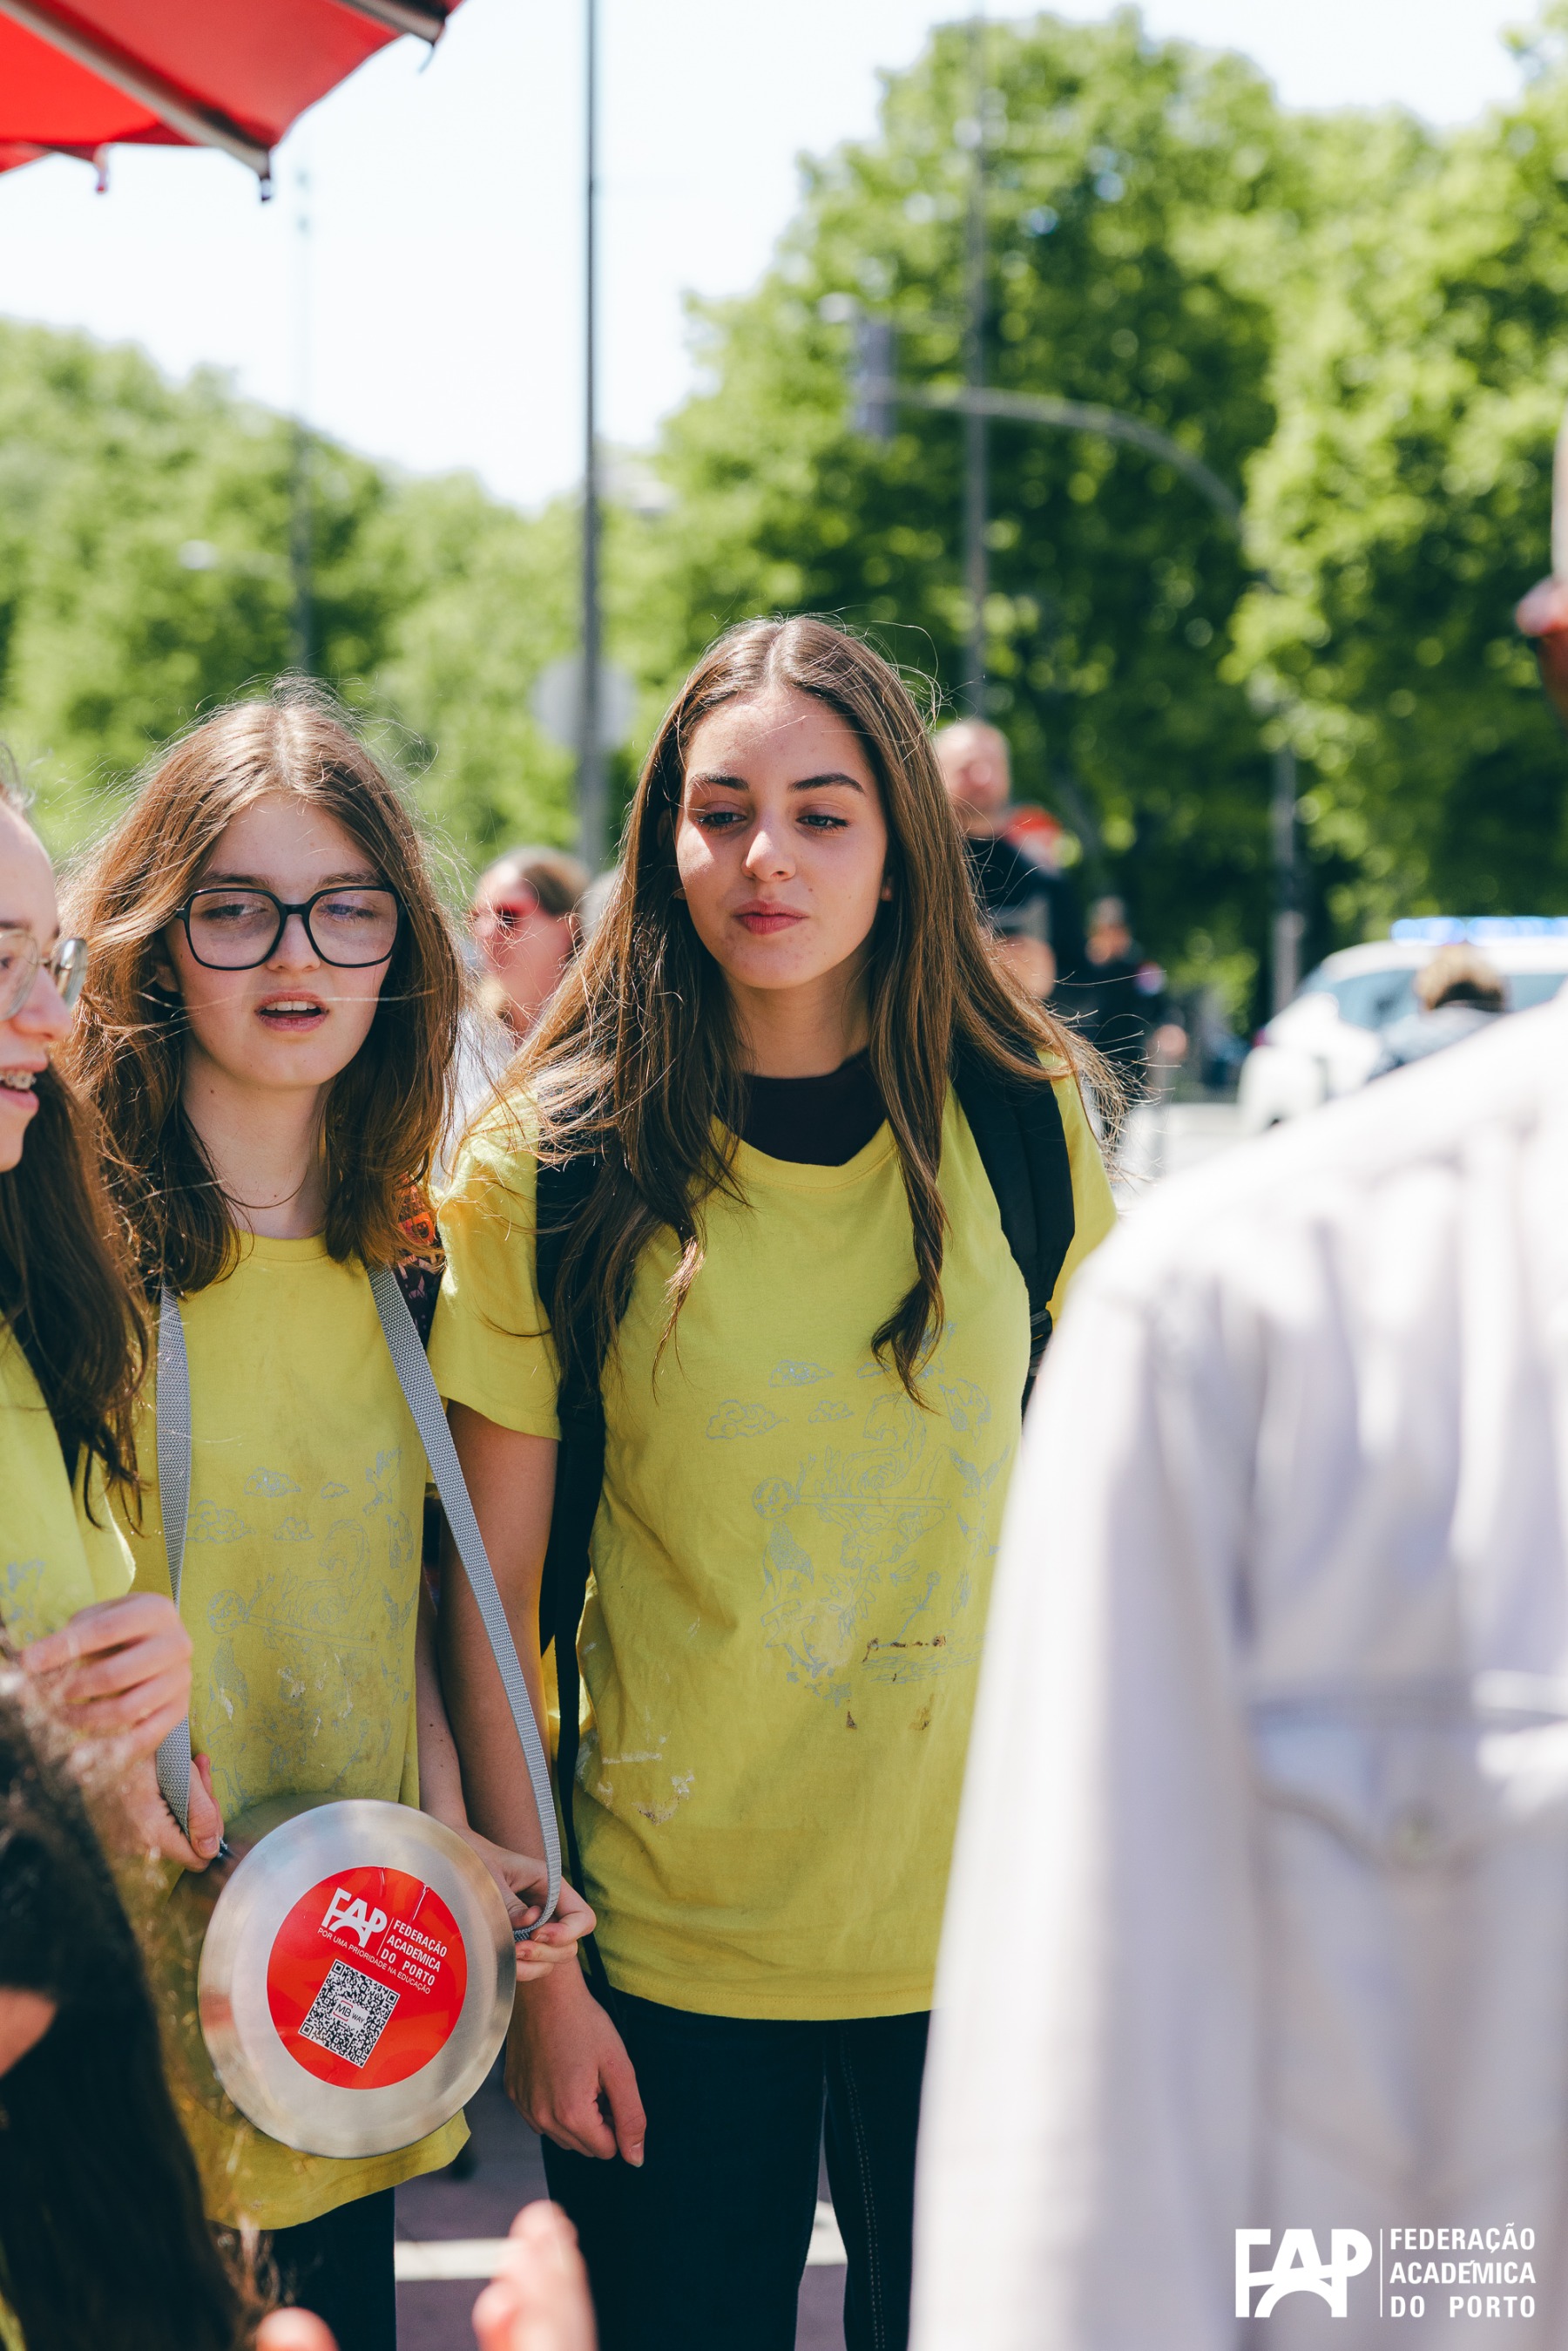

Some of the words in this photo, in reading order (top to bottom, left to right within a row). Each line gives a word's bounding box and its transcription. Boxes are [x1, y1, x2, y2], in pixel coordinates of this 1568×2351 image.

[321, 1887, 388, 1948] FAP
[387, 1934, 442, 1973] ACADÉMICA
[393, 1919, 448, 1958] FEDERAÇÃO
[317, 1928, 333, 1940] POR
[333, 1935, 348, 1949] UMA
[348, 1943, 387, 1970] PRIORIDADE
[388, 1963, 396, 1975] NA
[397, 1969, 431, 1995] EDUCAÇÃO
[381, 1948, 396, 1964] DO
[402, 1961, 436, 1986] PORTO
[335, 2003, 352, 2017] MB
[352, 2013, 365, 2023] WAY
